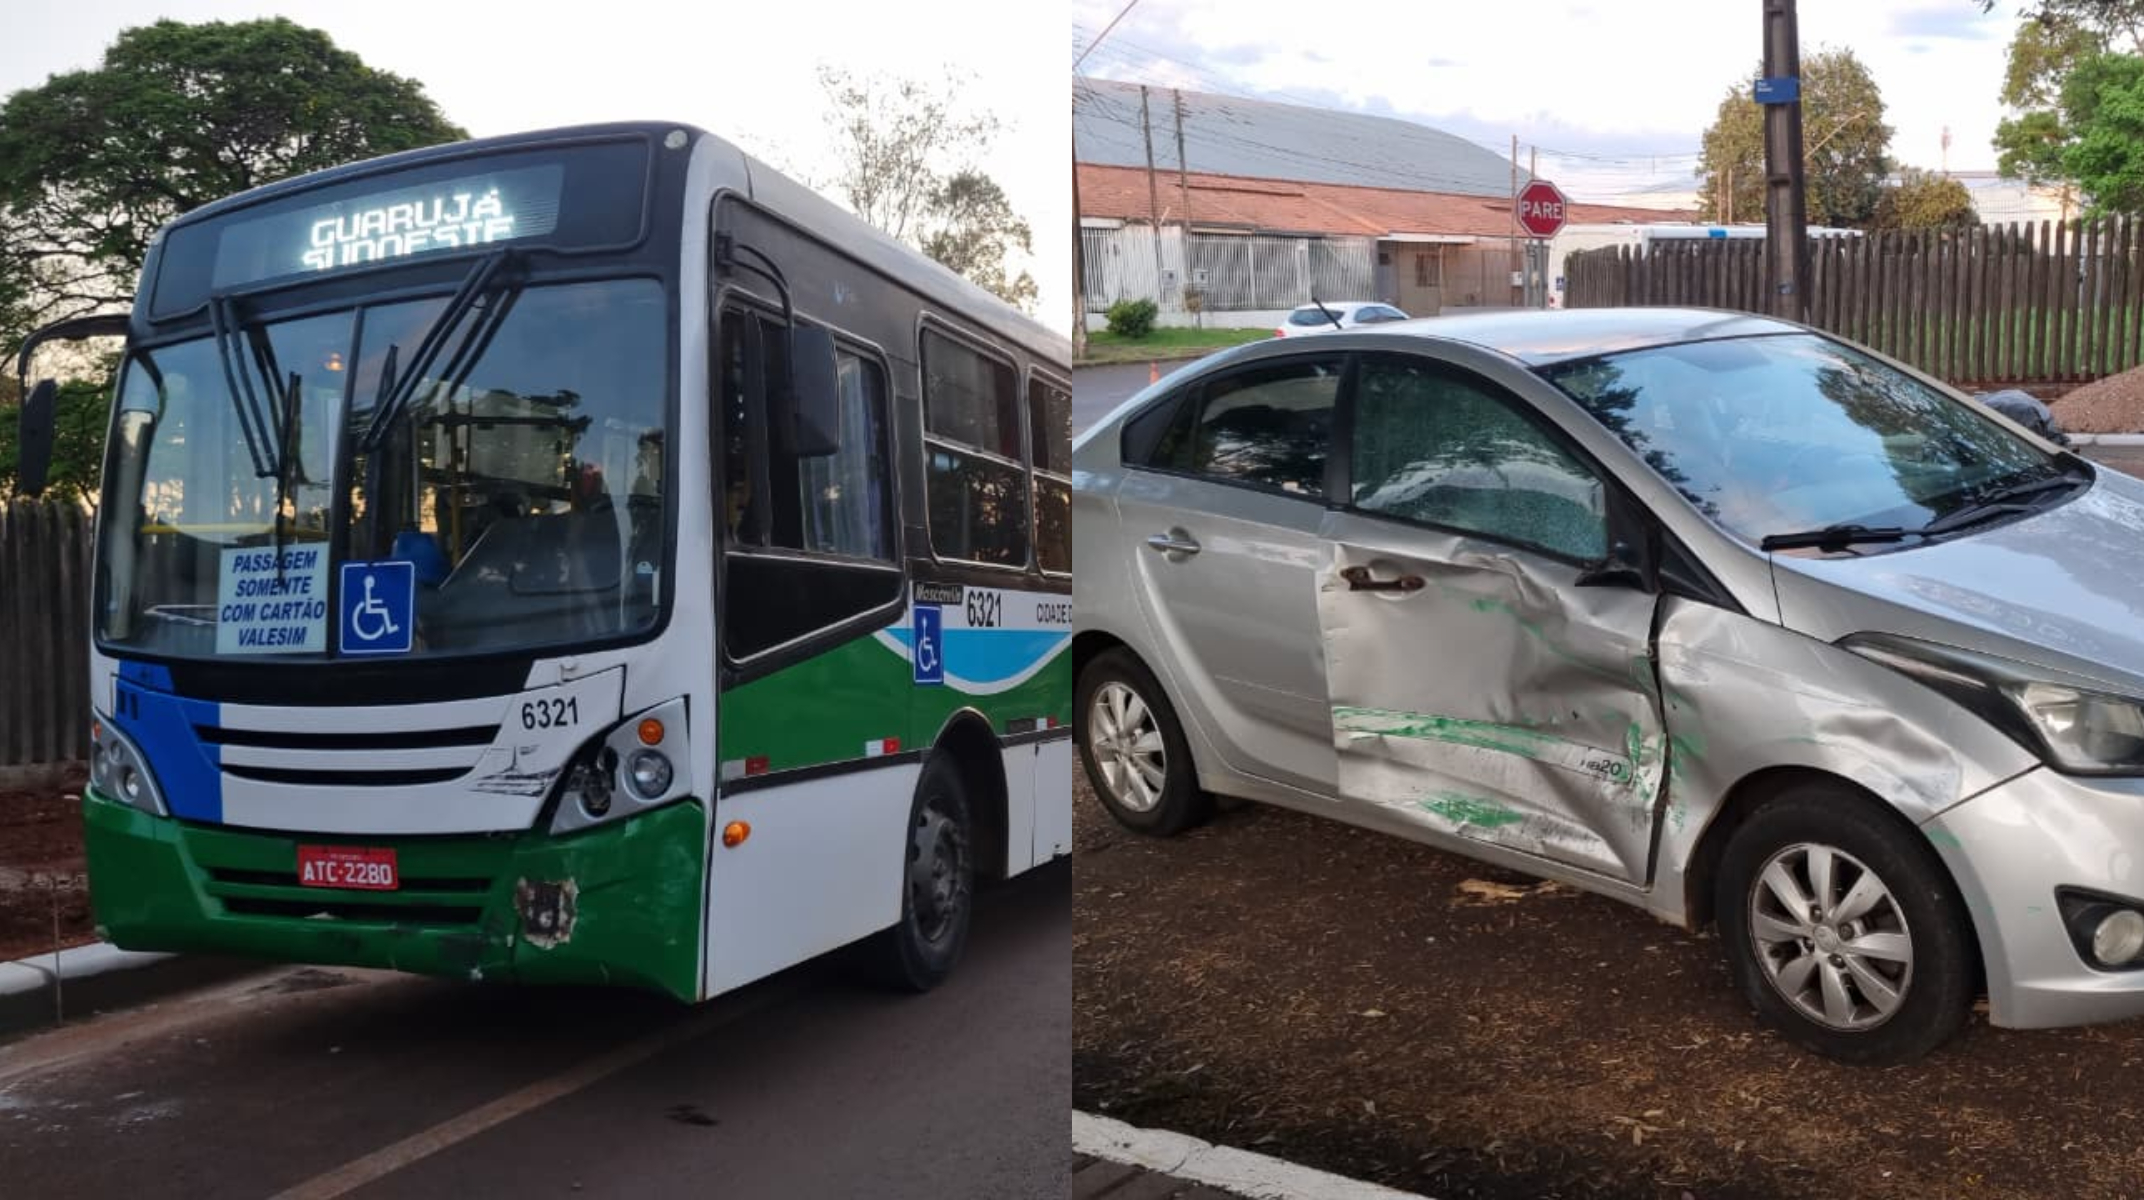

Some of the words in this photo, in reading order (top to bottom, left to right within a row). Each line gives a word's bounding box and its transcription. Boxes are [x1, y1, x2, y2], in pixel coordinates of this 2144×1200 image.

[311, 189, 501, 248] GUARUJÁ
[1522, 201, 1562, 219] PARE
[233, 551, 318, 573] PASSAGEM
[235, 576, 313, 597] SOMENTE
[221, 604, 256, 622] COM
[260, 597, 325, 620] CARTÃO
[967, 590, 1001, 628] 6321
[238, 627, 308, 646] VALESIM
[521, 697, 578, 730] 6321
